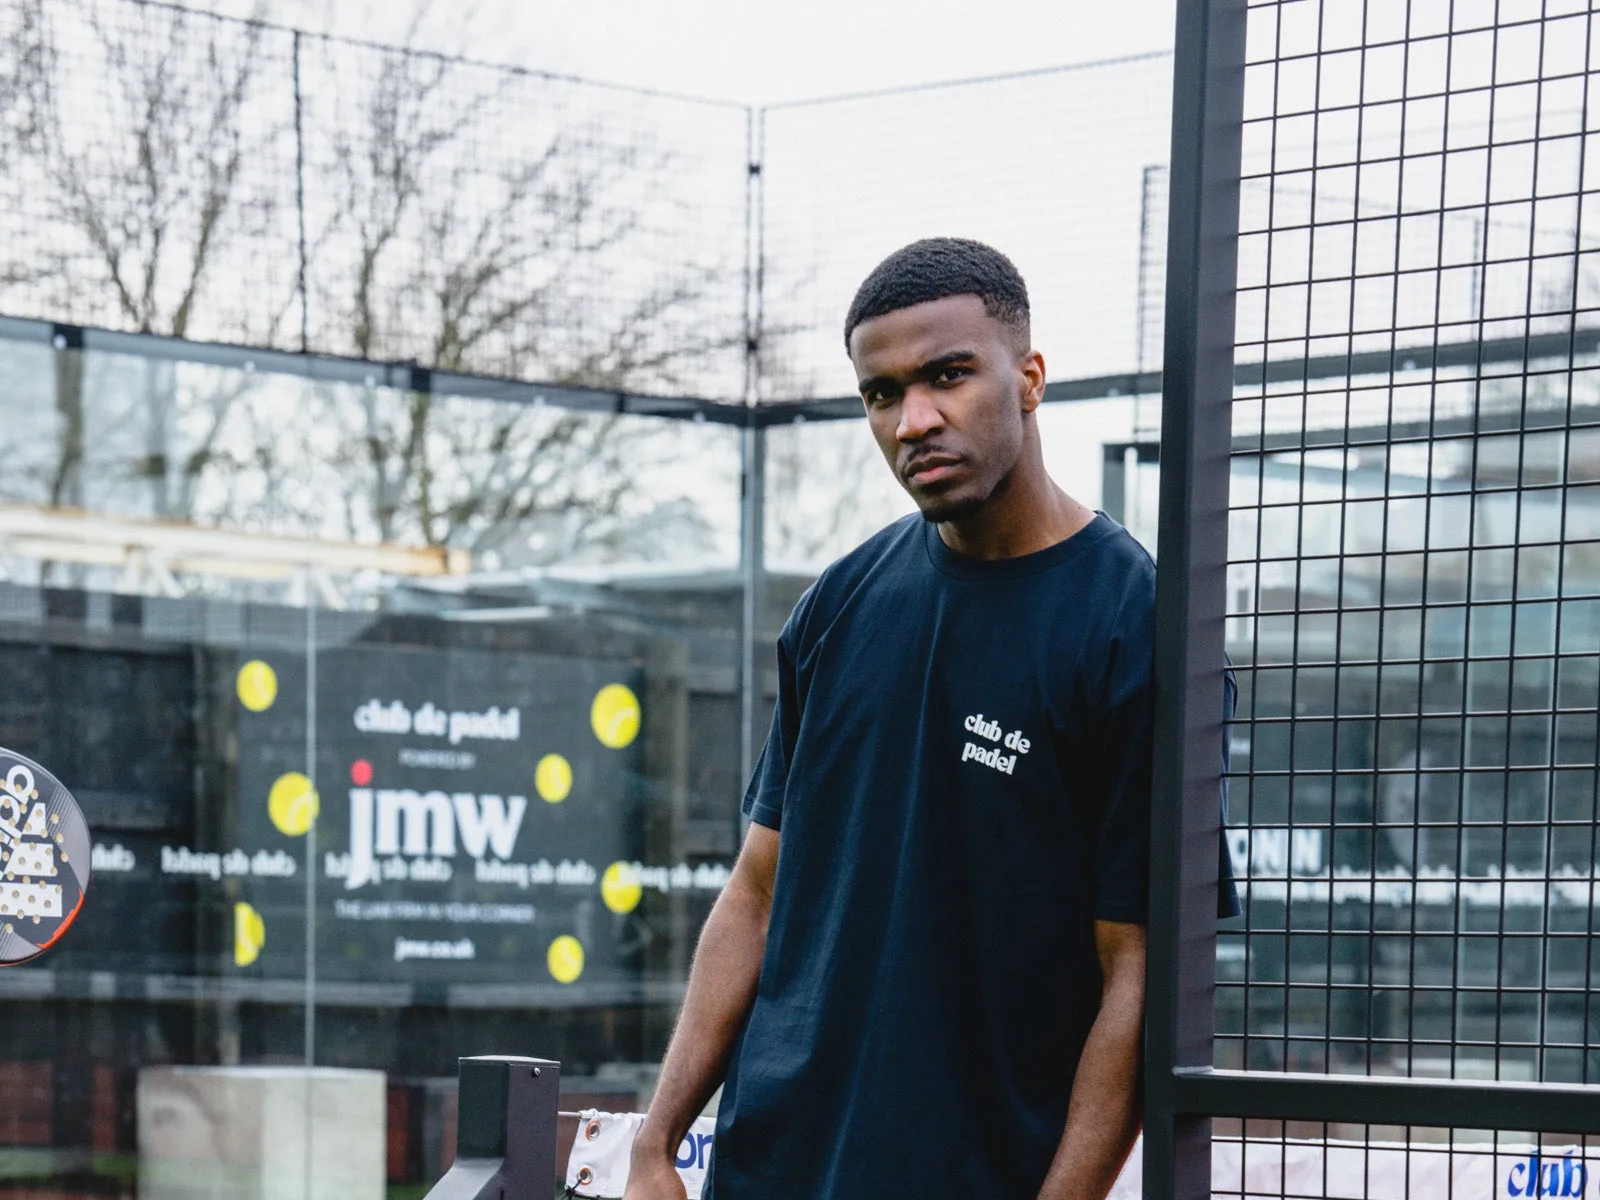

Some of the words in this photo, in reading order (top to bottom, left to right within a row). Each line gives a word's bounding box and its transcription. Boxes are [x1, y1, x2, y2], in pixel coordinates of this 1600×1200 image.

[353, 698, 412, 734] club
[413, 702, 448, 736] de
[448, 706, 520, 745] padel
[964, 713, 1003, 742] club
[1004, 730, 1032, 754] de
[961, 741, 1018, 776] padel
[348, 758, 528, 890] jmw
[1508, 1150, 1589, 1198] club
